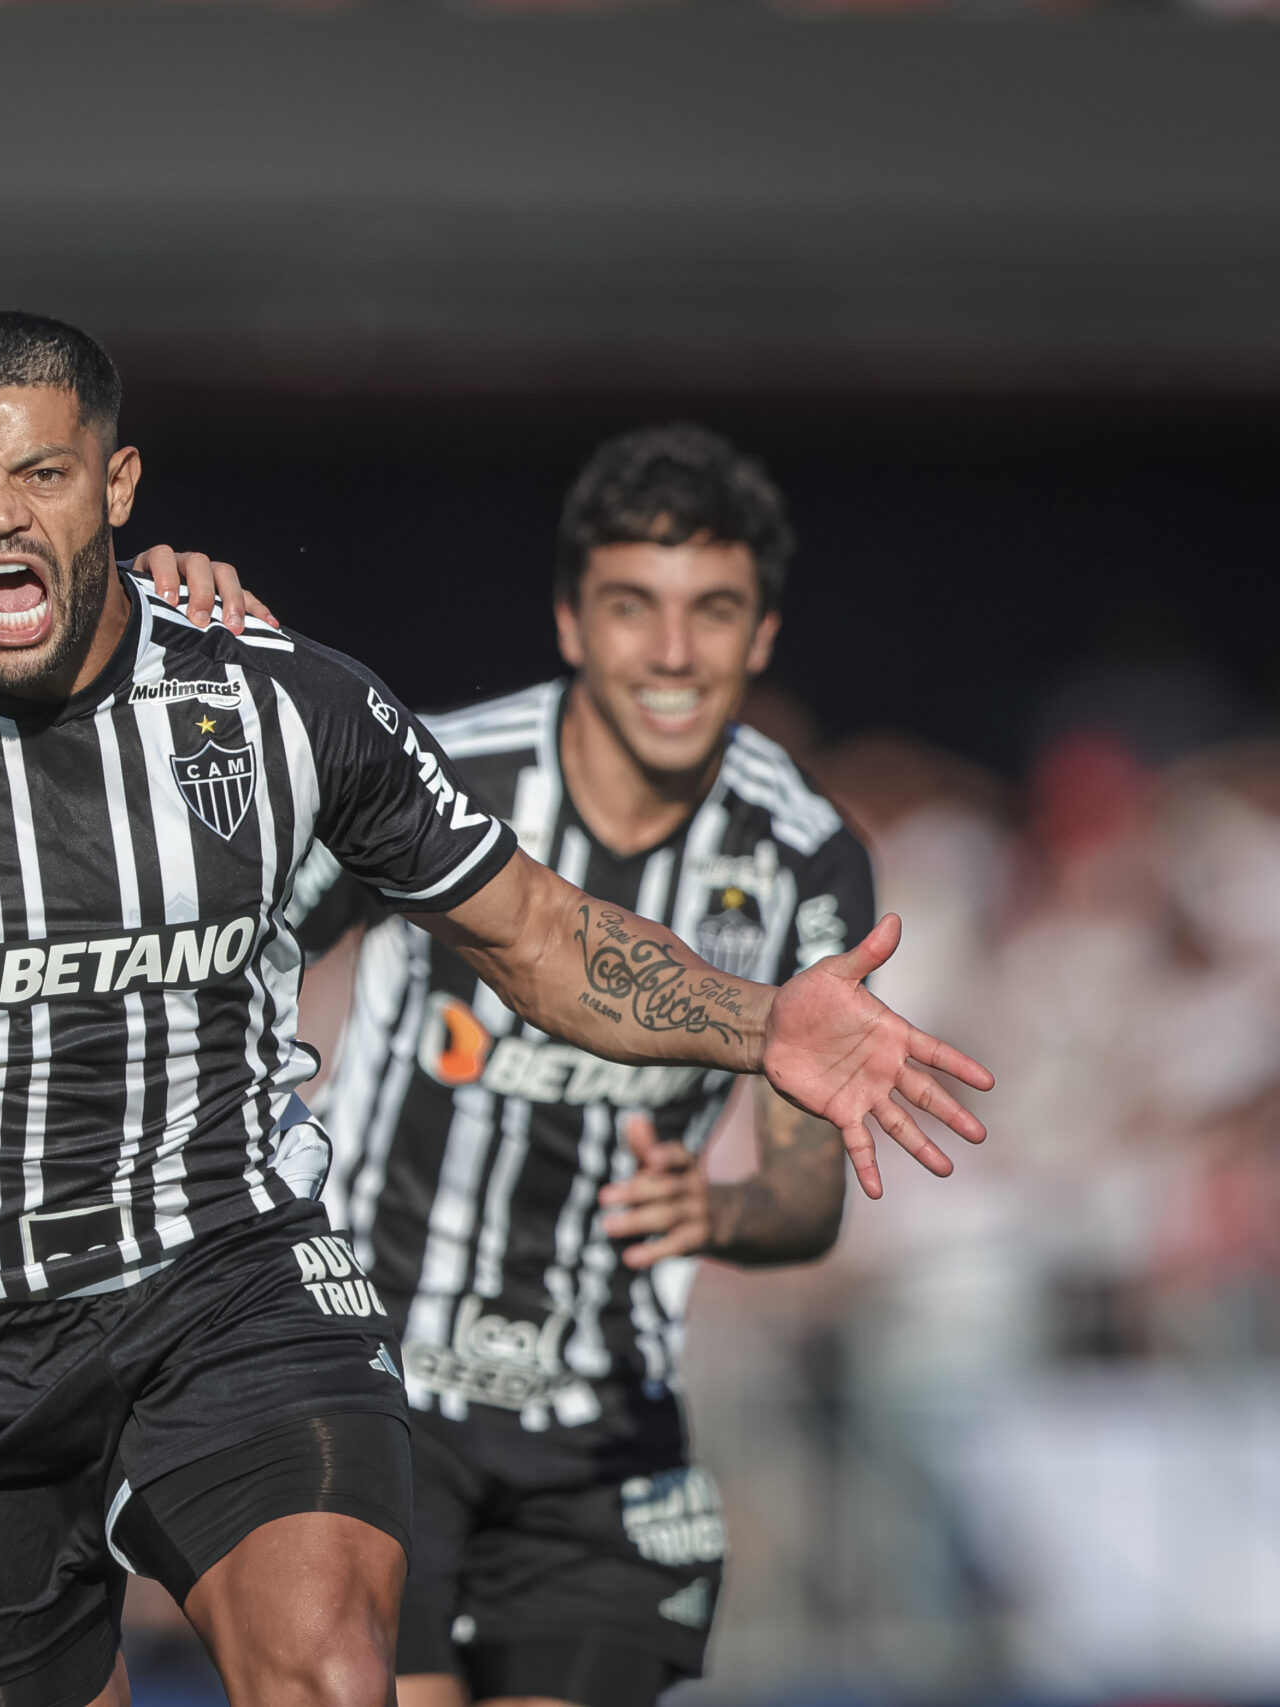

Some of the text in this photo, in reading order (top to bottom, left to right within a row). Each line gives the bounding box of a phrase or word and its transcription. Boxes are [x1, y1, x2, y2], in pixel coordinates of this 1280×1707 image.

[132, 681, 241, 700] Multimarcas
[187, 758, 245, 779] CAM
[403, 726, 489, 830] MRV
[304, 1280, 387, 1317] TRUC
